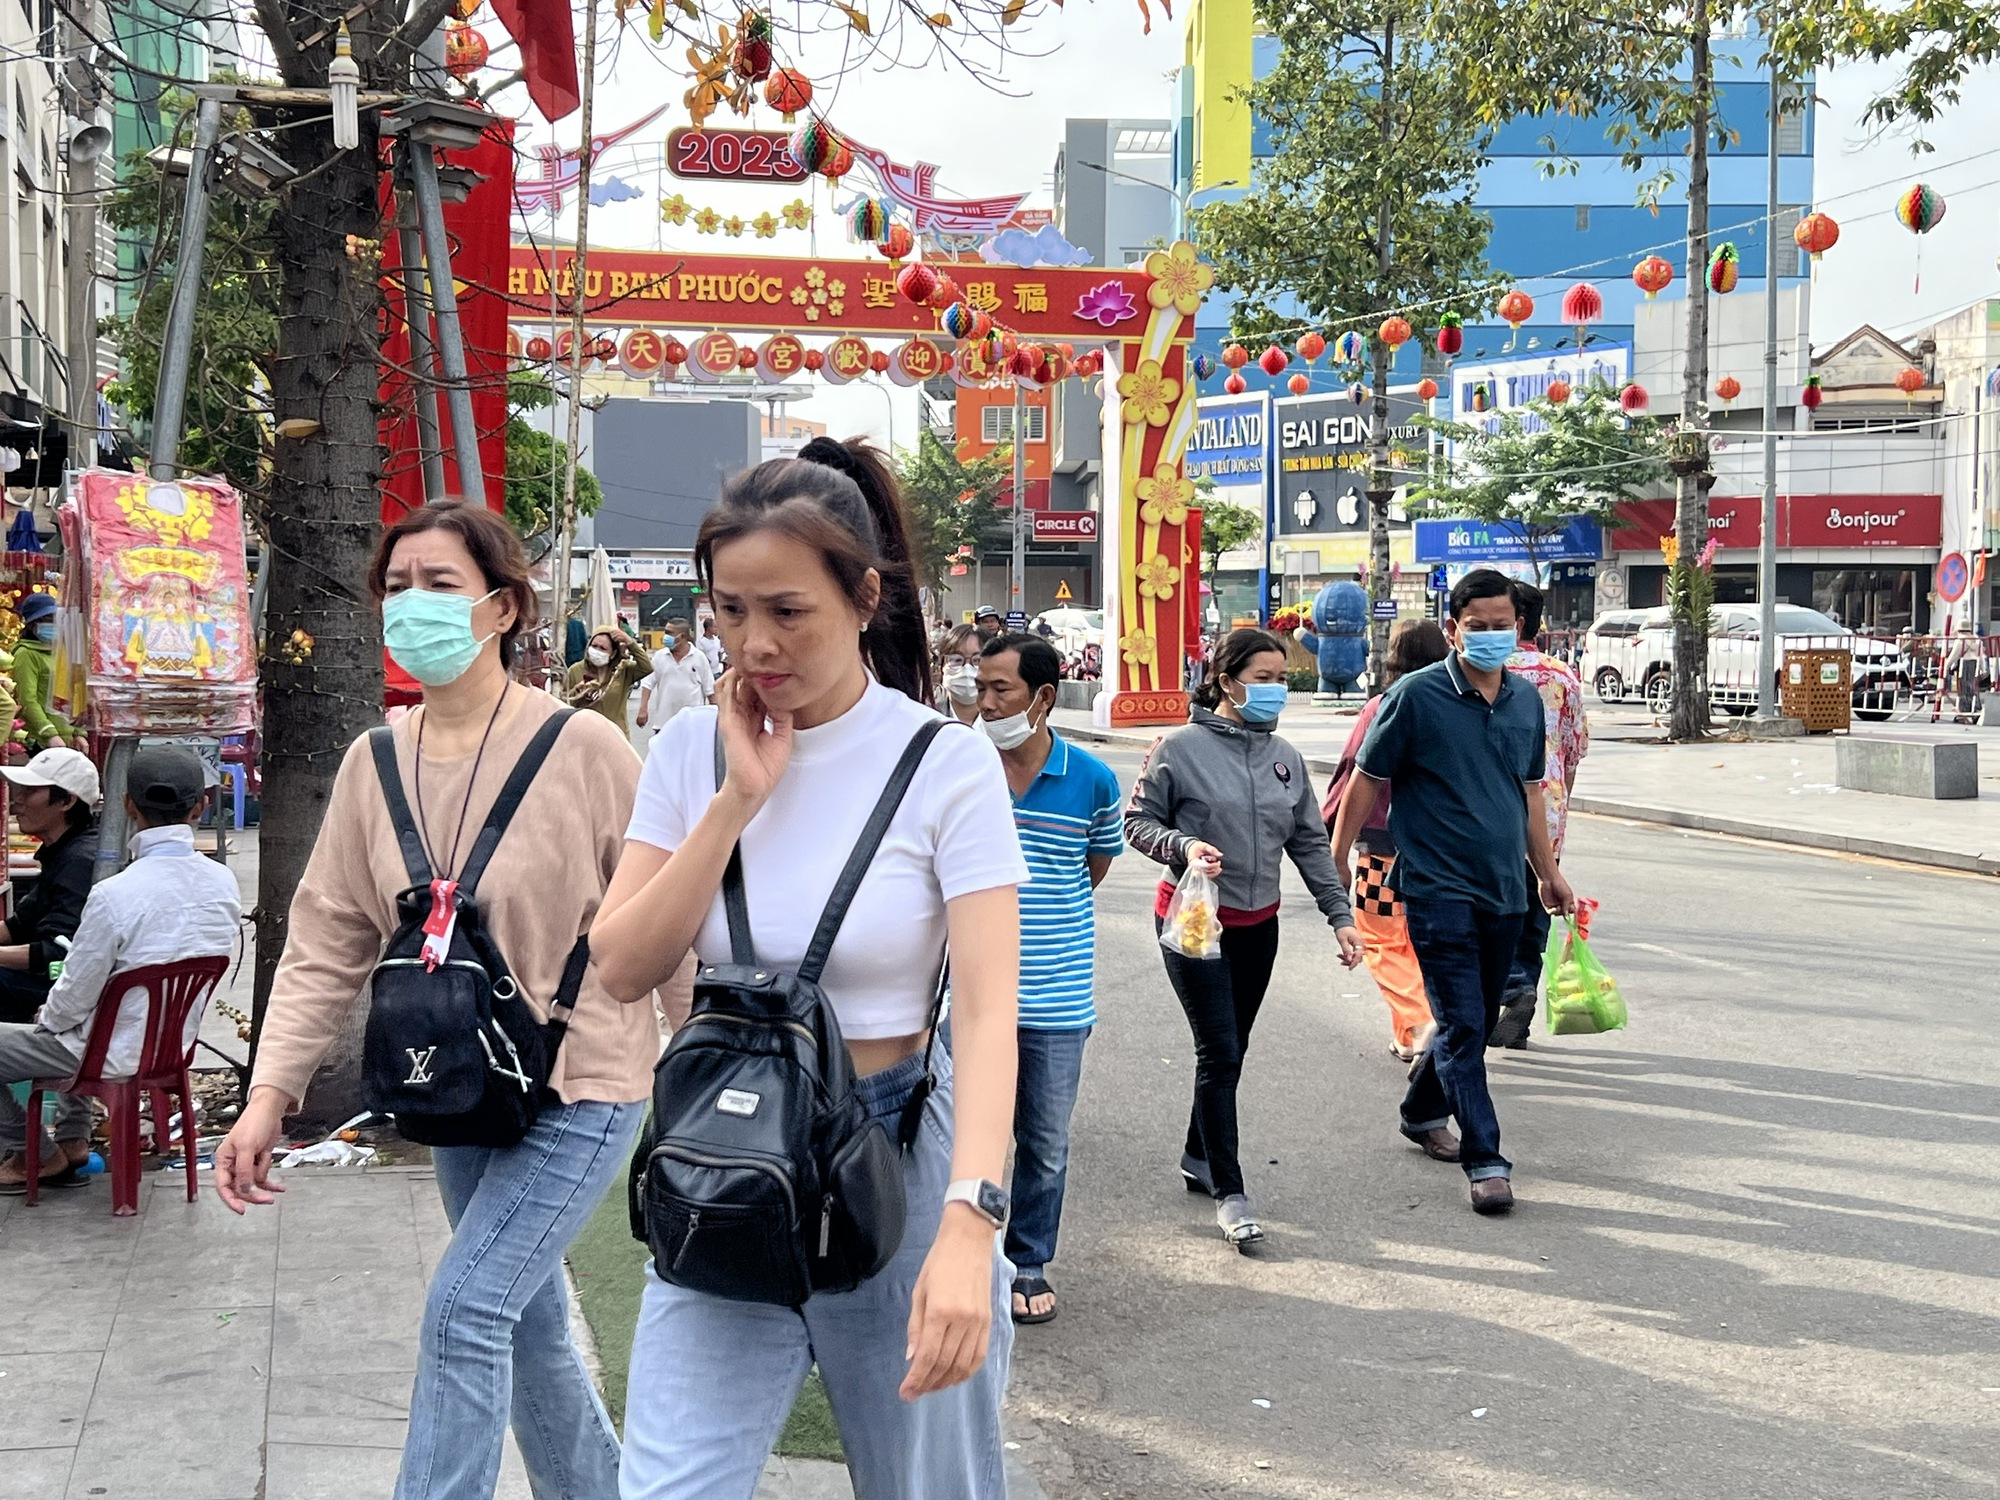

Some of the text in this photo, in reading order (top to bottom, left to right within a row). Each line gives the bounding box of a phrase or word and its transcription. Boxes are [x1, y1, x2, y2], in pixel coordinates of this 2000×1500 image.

[678, 132, 803, 177] 2023
[609, 271, 671, 300] BAN
[678, 269, 783, 304] PHƯỚC
[862, 272, 1048, 314] 聖賜福
[1282, 414, 1374, 448] SAI GON
[1035, 519, 1076, 530] CIRCLE
[1826, 508, 1899, 533] Bonjour
[1474, 531, 1490, 545] FA
